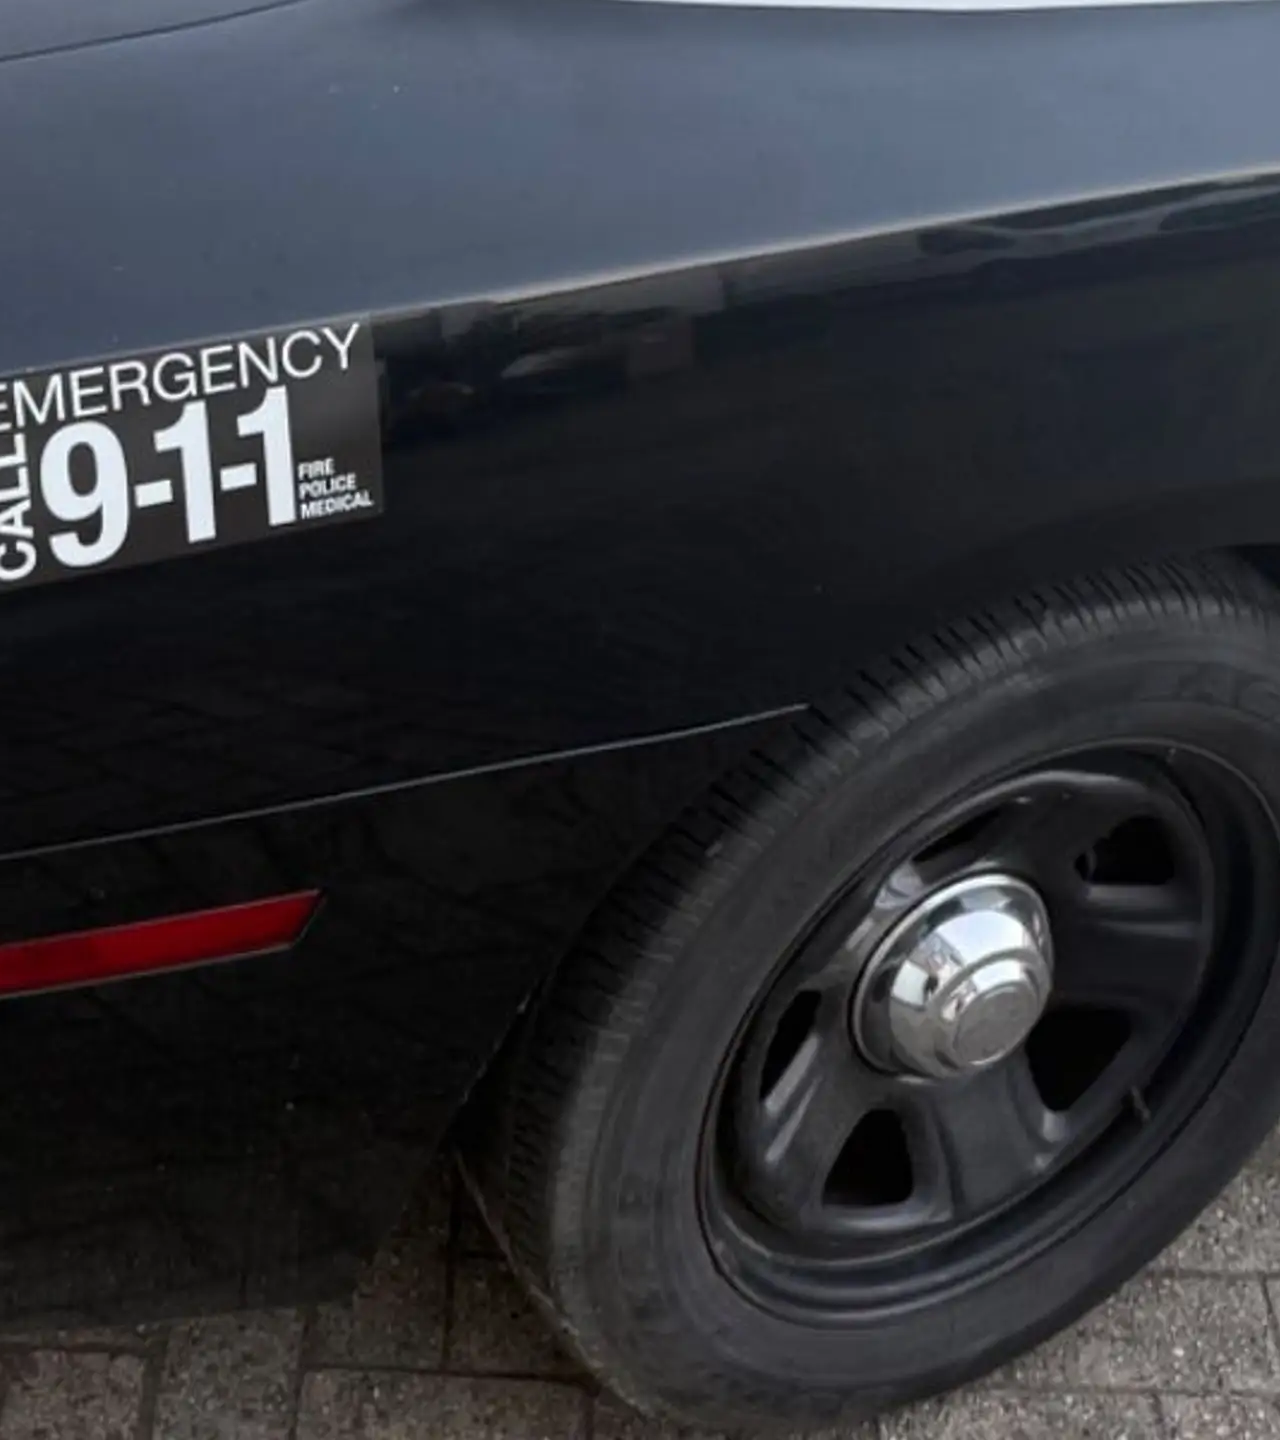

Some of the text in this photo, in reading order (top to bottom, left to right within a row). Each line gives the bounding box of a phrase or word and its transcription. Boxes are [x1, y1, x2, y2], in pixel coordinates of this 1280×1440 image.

[39, 385, 297, 568] 9-1-1
[297, 458, 336, 481] FIRE
[298, 473, 358, 500] POLICE
[300, 490, 375, 520] MEDICAL
